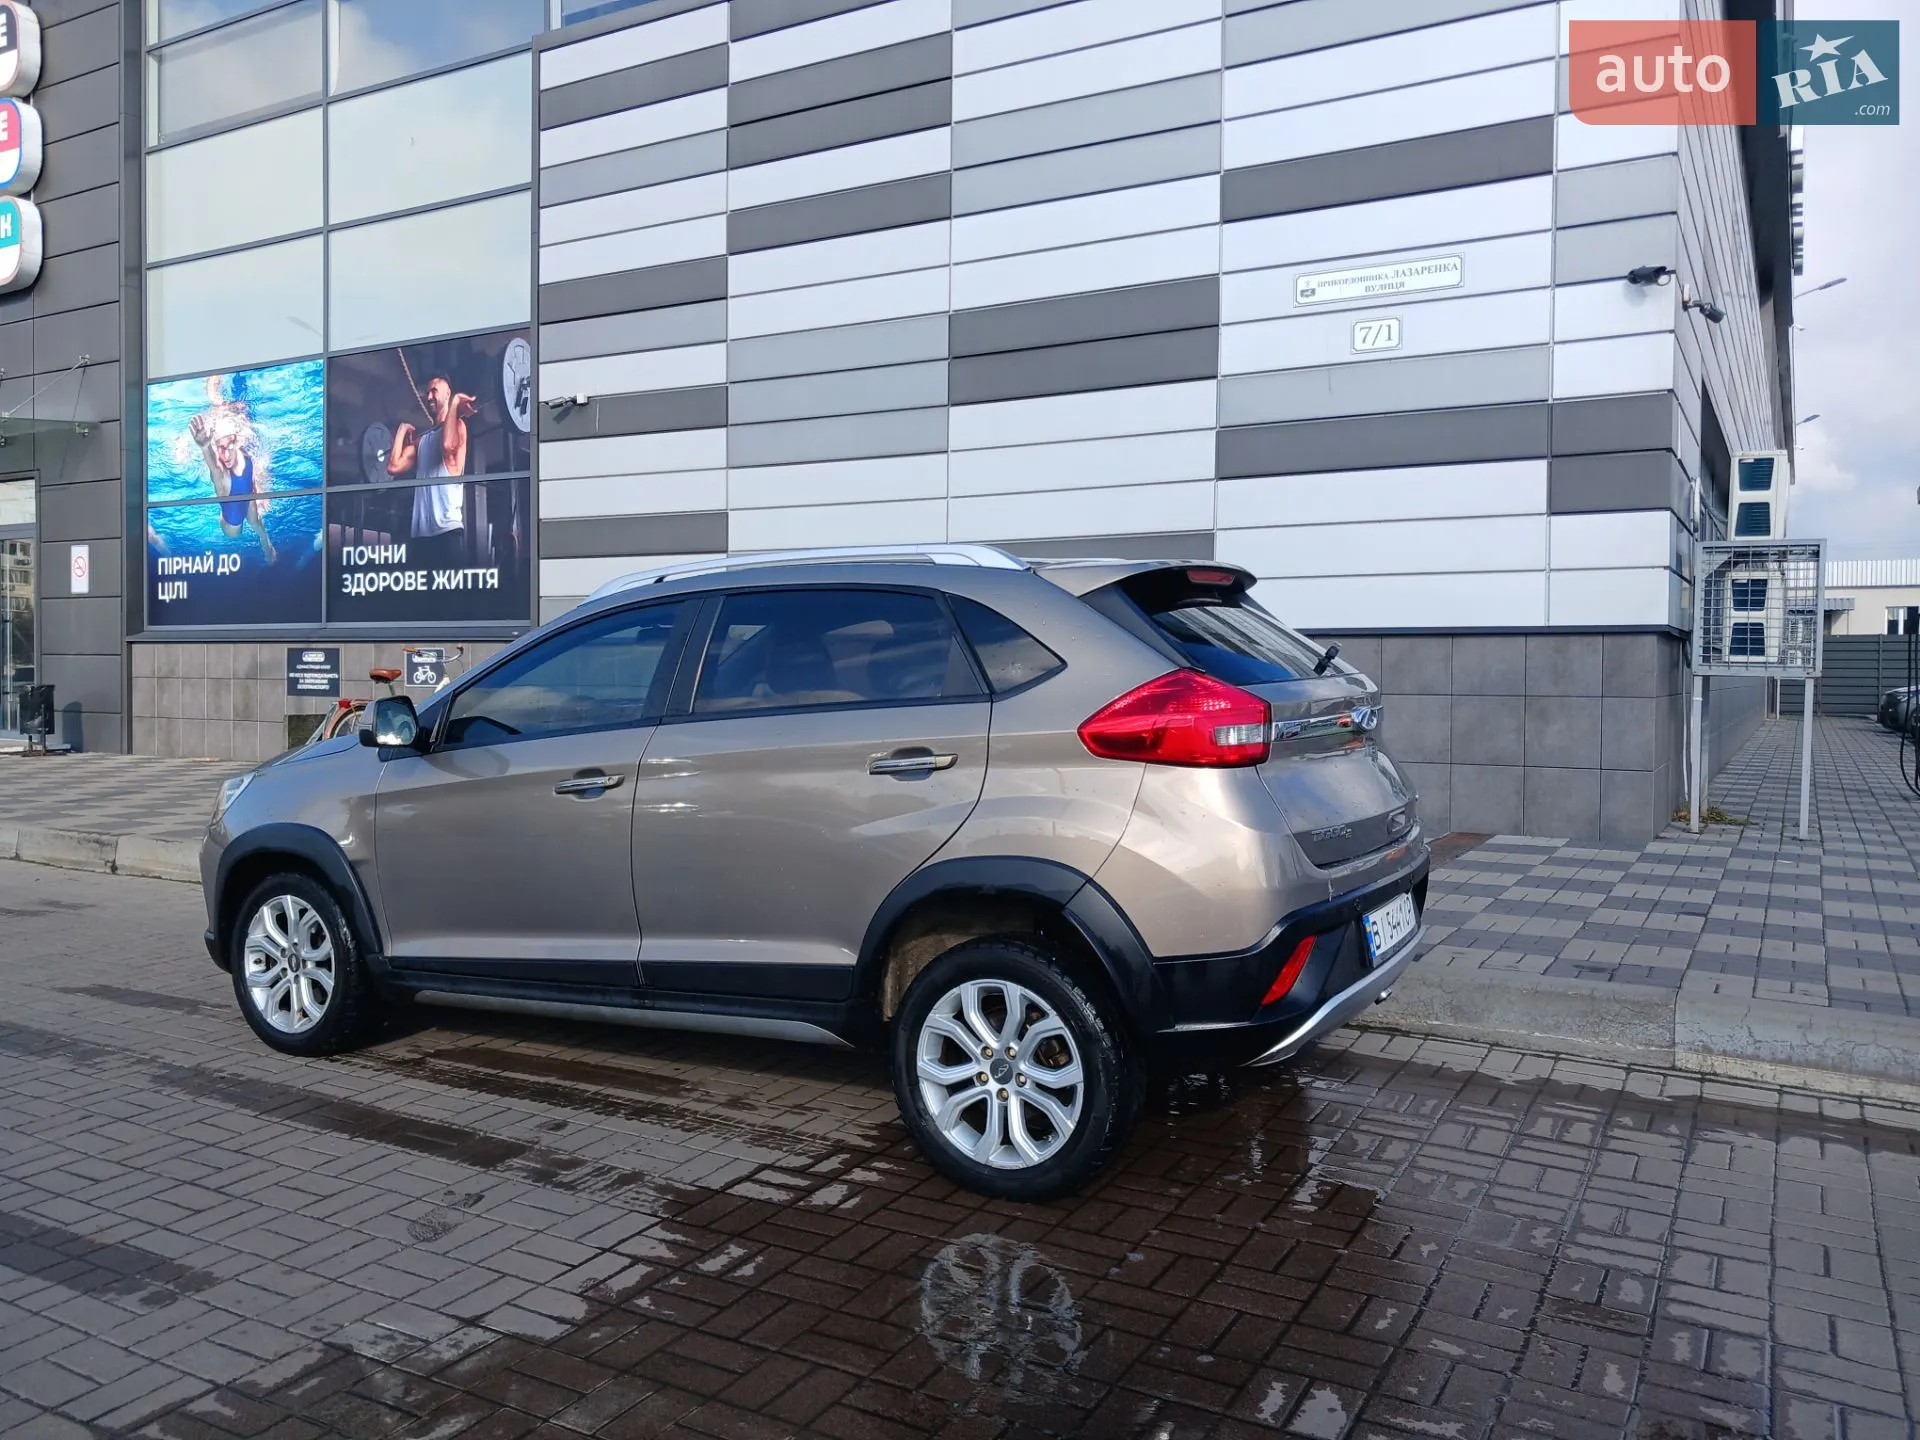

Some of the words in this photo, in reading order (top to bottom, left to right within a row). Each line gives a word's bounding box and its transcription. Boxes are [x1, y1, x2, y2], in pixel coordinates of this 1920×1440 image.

[1391, 262, 1459, 279] ЛАЗАРЕНКА
[1364, 281, 1406, 293] ВУЛИЦЯ
[1359, 324, 1394, 347] 7/1
[158, 551, 214, 575] ПІРНАЙ
[217, 553, 241, 576] ДО
[342, 544, 406, 566] ПОЧНИ
[158, 581, 188, 602] ЦІЛІ
[341, 570, 428, 596] ЗДОРОВЕ
[432, 568, 499, 591] ЖИТТЯ
